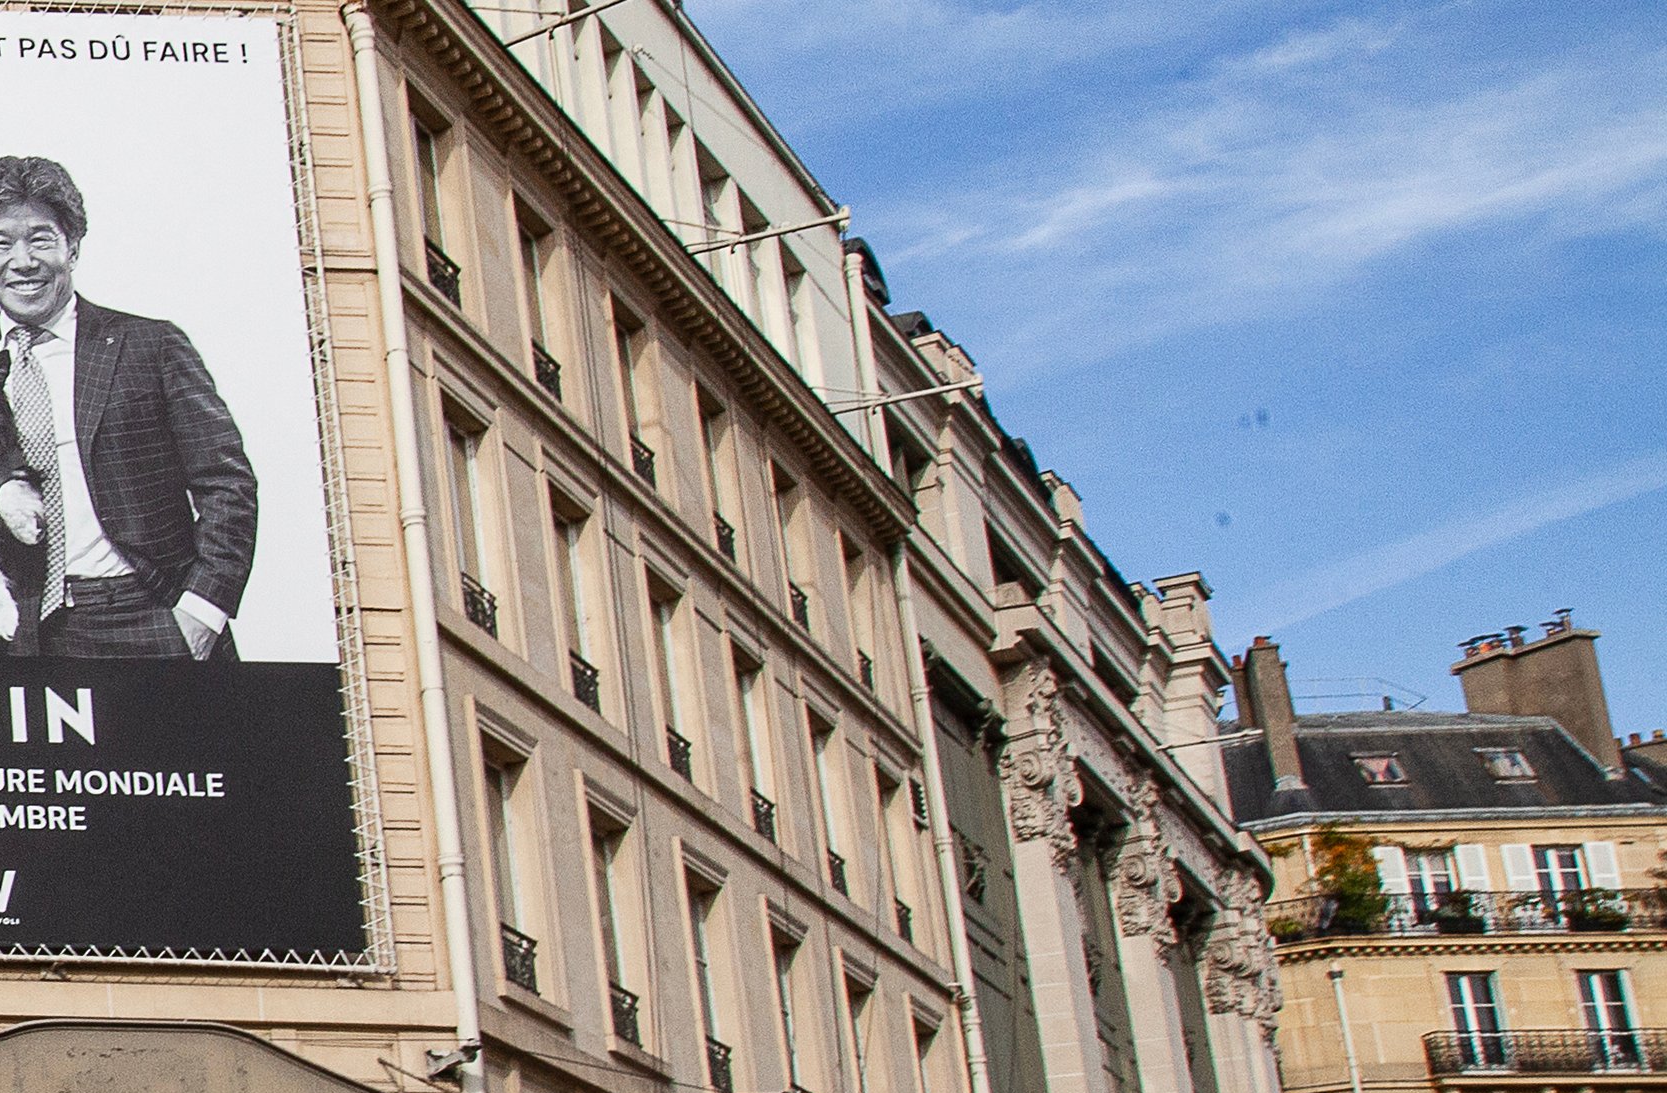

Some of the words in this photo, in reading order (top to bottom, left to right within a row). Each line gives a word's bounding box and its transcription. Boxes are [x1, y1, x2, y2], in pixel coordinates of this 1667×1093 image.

[19, 38, 76, 59] PAS
[89, 35, 130, 60] DÛ
[143, 42, 229, 63] FAIRE
[241, 44, 247, 63] !
[55, 770, 224, 797] MONDIALE
